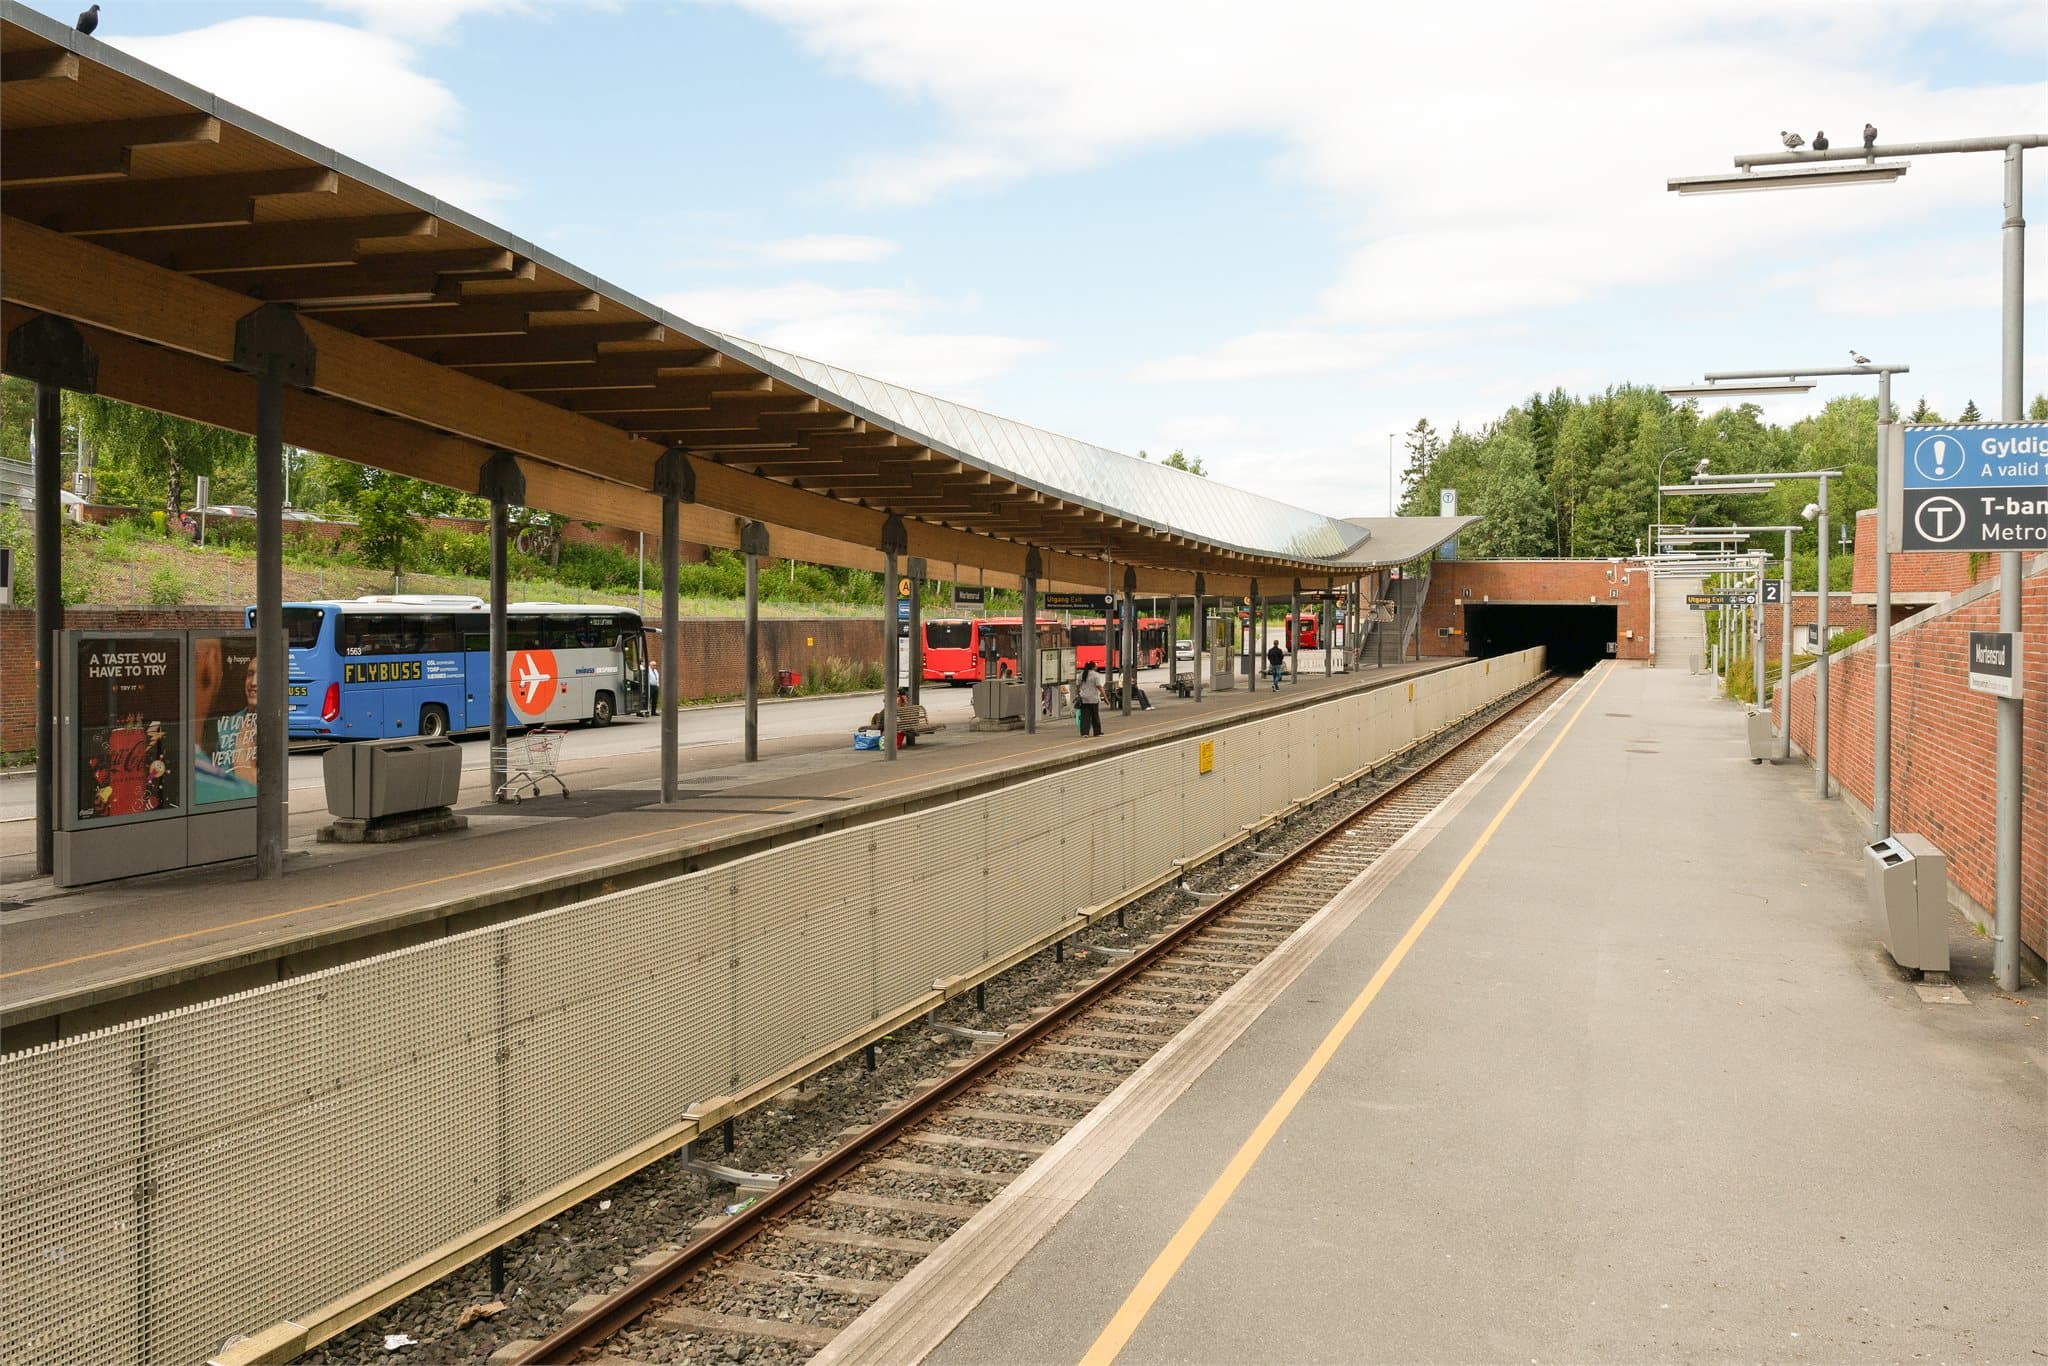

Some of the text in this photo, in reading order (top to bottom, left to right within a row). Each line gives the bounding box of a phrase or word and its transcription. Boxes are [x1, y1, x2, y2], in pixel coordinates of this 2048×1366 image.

[1981, 437, 2048, 458] Gyldig
[1981, 463, 1993, 477] A
[1998, 462, 2039, 477] valid
[1982, 523, 2047, 540] Metro
[1767, 586, 1776, 600] 2
[89, 652, 167, 665] A TASTE YOU
[346, 647, 362, 656] 1563
[1976, 643, 2005, 666] Mortensrud
[89, 665, 167, 678] HAVE TO TRY
[345, 662, 421, 682] FLYBUSS
[217, 715, 230, 732] VI
[220, 732, 240, 749] DET
[245, 746, 257, 762] DE
